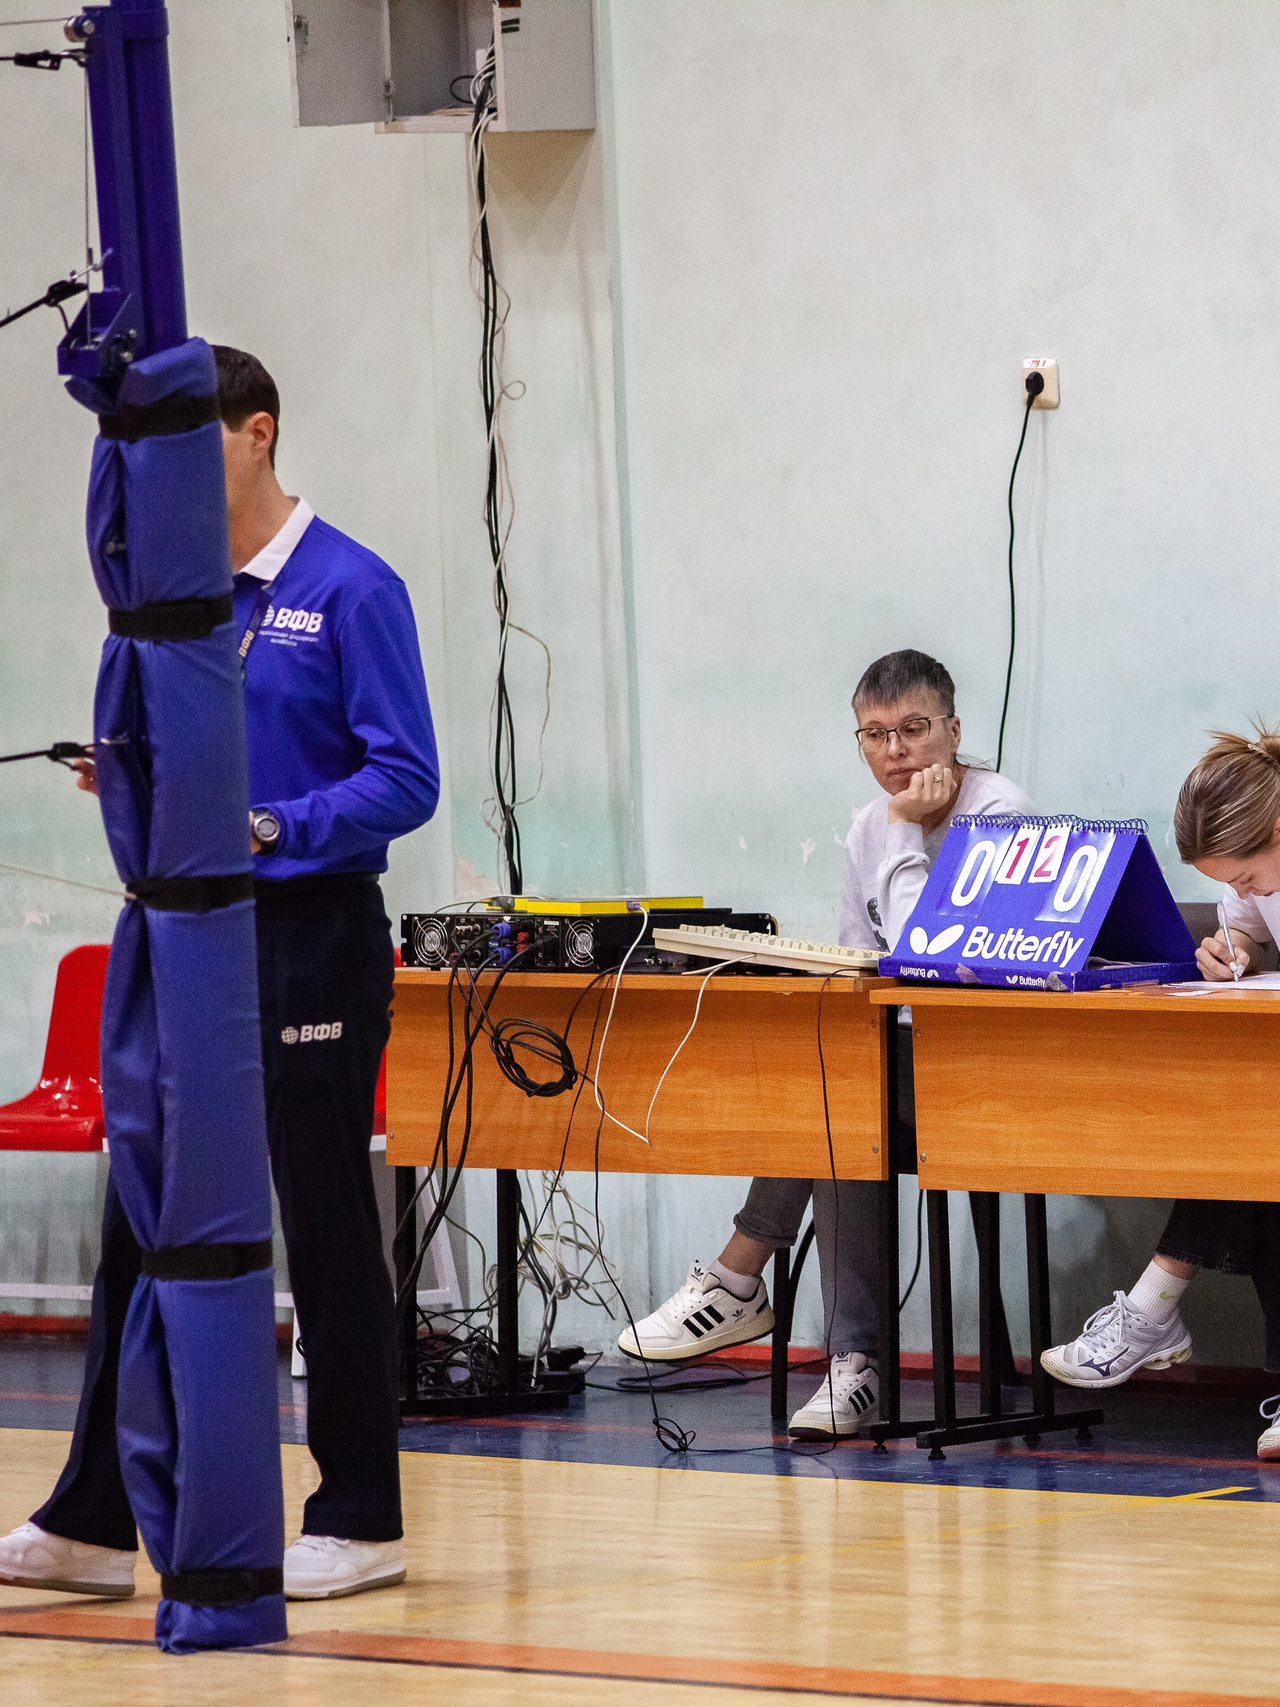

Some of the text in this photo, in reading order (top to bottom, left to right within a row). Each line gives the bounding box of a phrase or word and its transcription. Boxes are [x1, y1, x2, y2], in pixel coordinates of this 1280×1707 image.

[273, 607, 324, 633] ВФВ
[951, 835, 1098, 912] 0 1 2 0
[961, 925, 1084, 968] Butterfly
[1019, 975, 1046, 989] Butterfly
[299, 1021, 343, 1043] ВФВ
